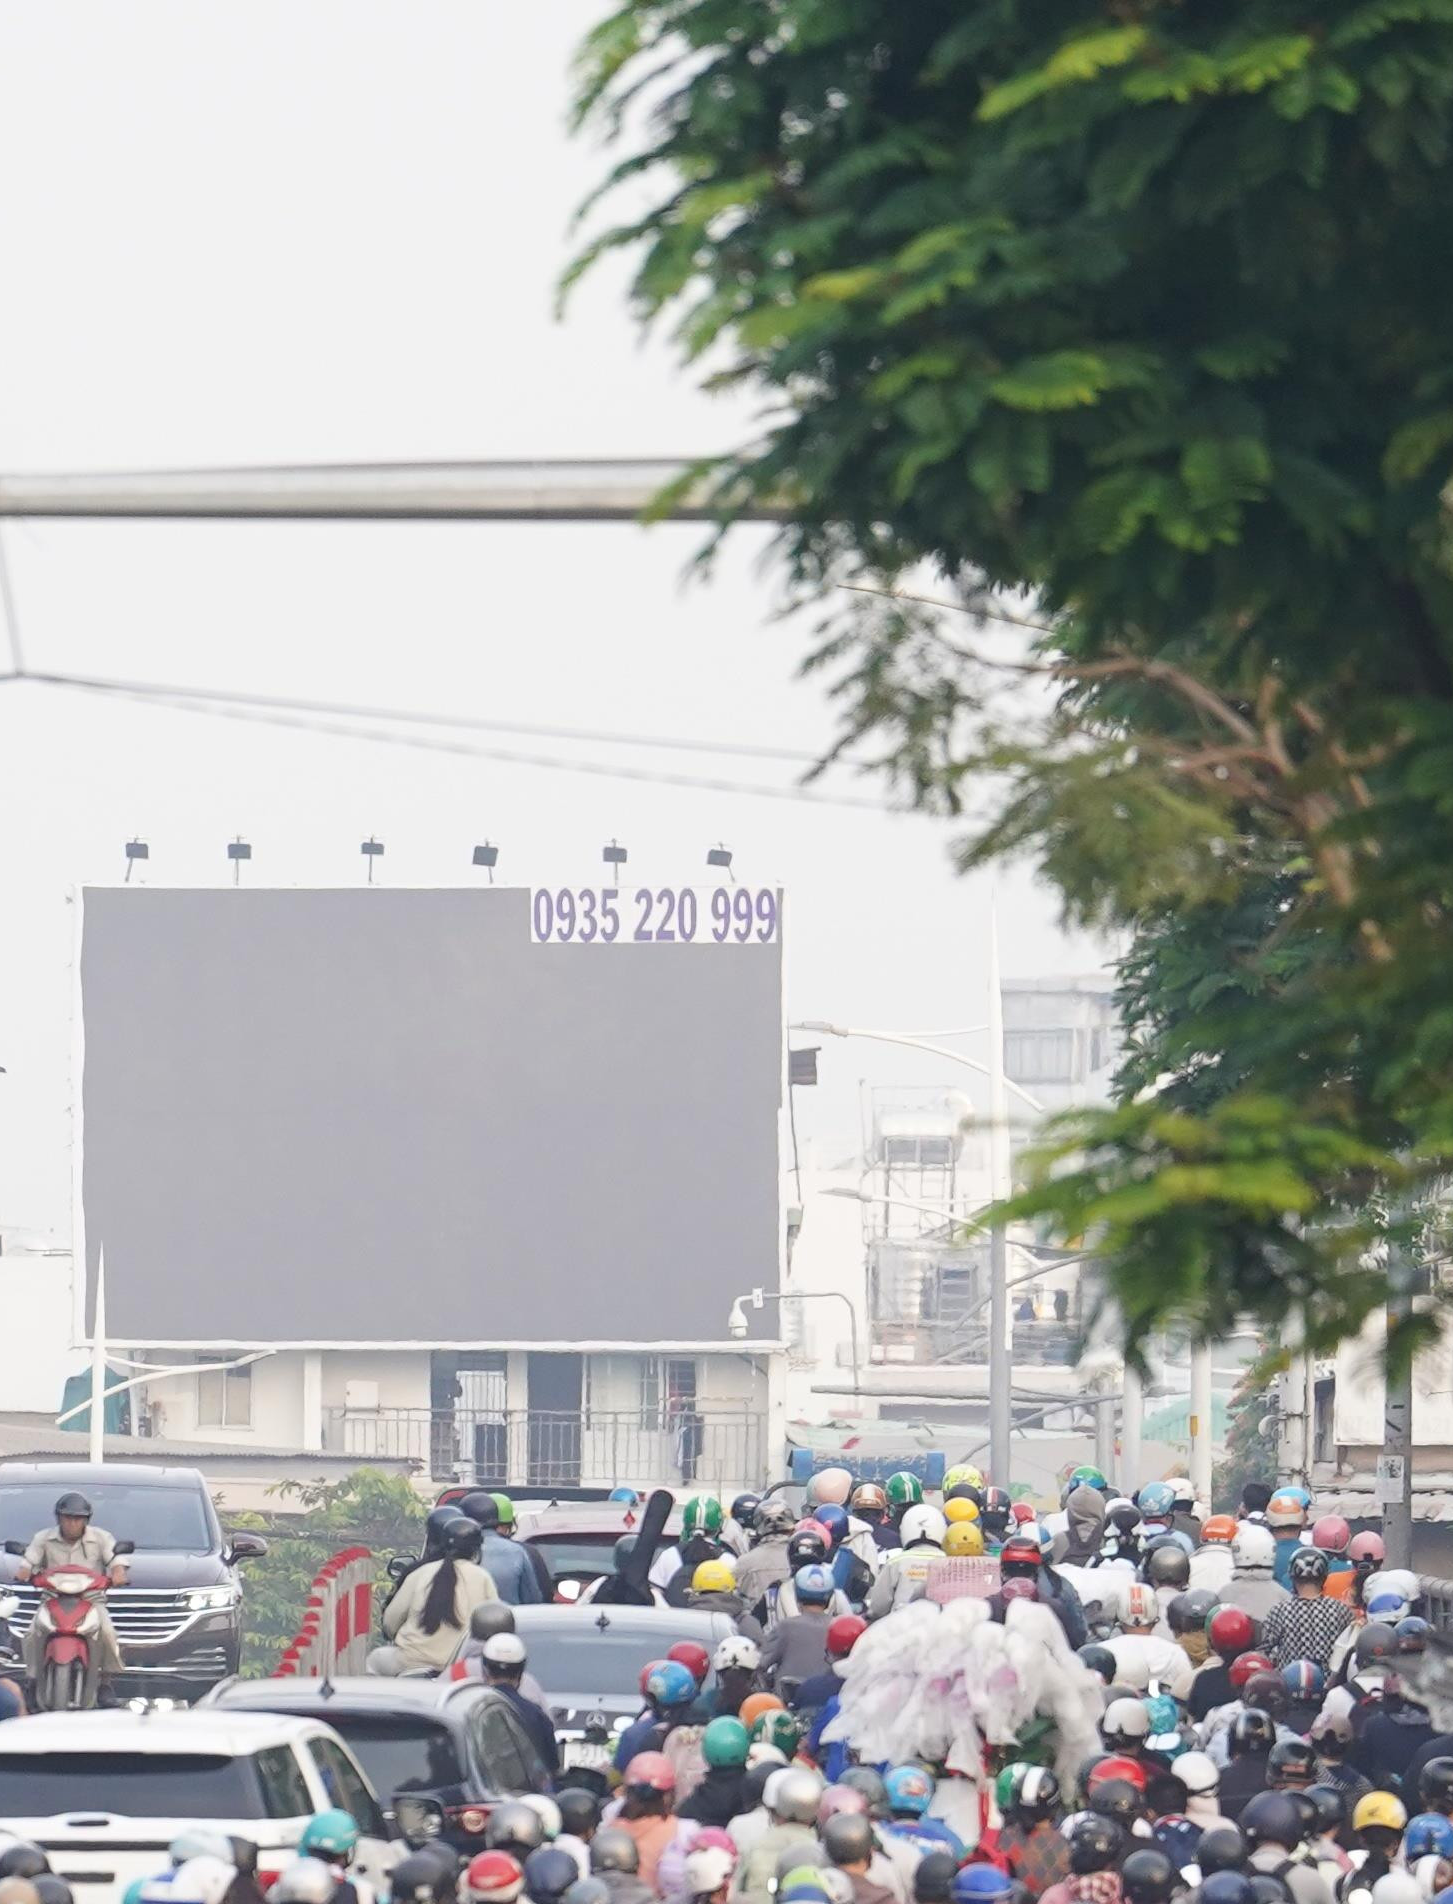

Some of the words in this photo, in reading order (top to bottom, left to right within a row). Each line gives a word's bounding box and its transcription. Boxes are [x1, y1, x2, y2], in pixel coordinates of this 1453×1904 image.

[533, 887, 620, 944] 0935
[633, 887, 698, 943] 220
[711, 887, 777, 944] 999
